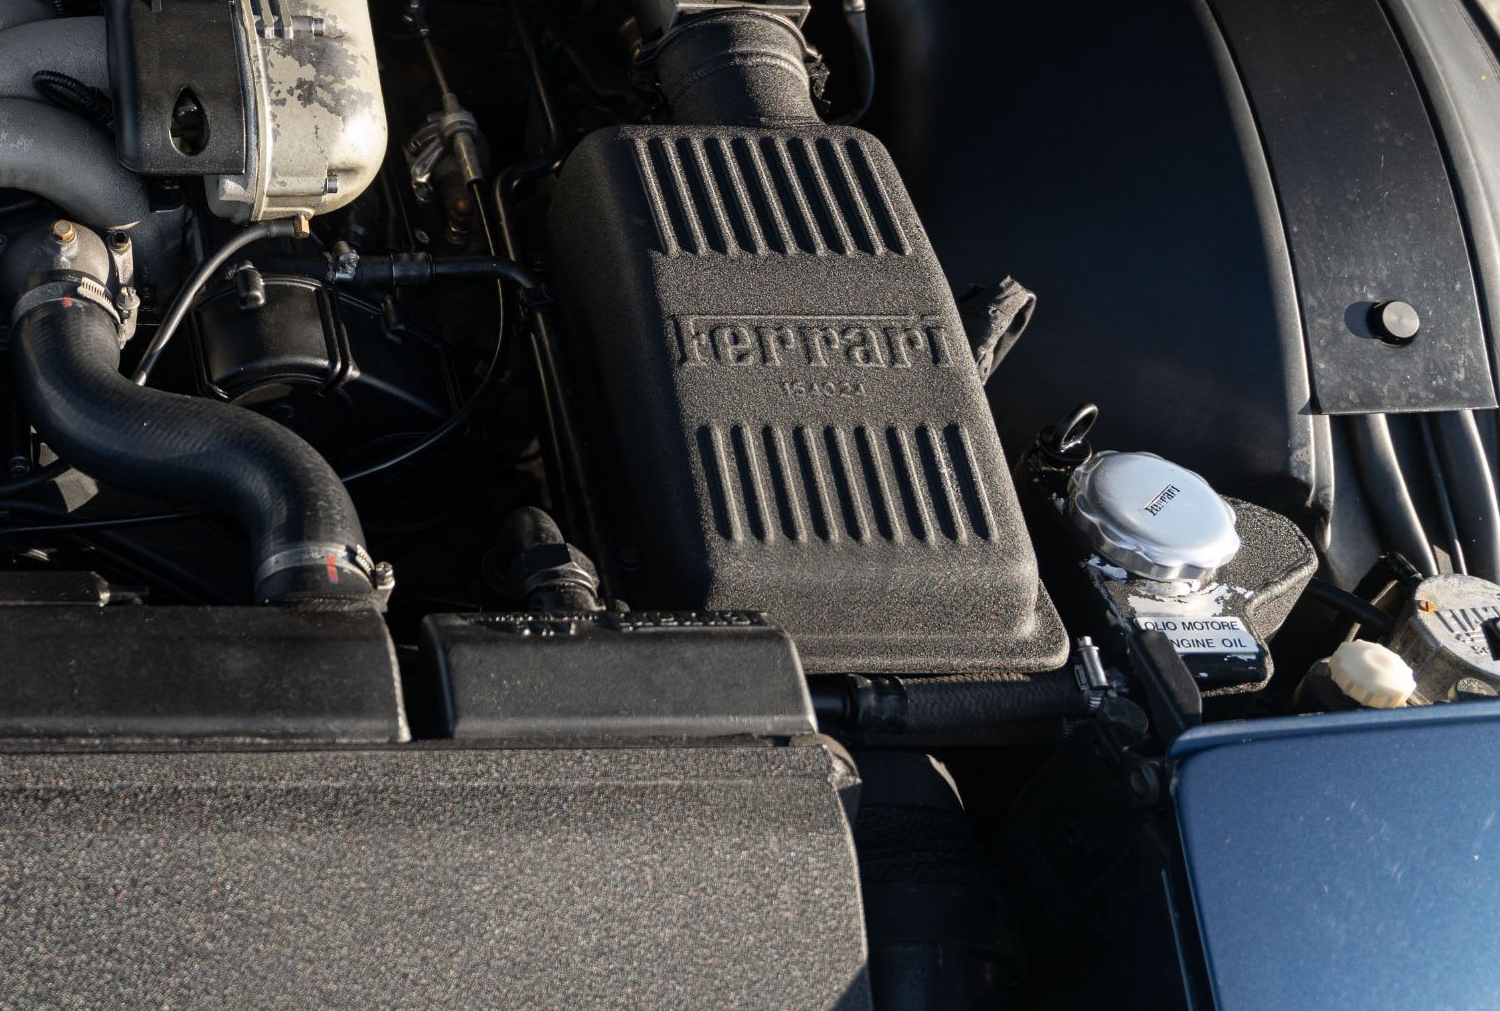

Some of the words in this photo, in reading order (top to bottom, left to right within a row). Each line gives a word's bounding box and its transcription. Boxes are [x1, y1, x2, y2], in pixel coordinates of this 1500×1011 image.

[674, 314, 954, 367] Ferrari
[1143, 483, 1181, 516] Ferrari
[1144, 621, 1178, 631] OLIO
[1182, 620, 1241, 631] MOTORE
[1170, 638, 1216, 649] NGINE
[1221, 638, 1247, 648] OIL
